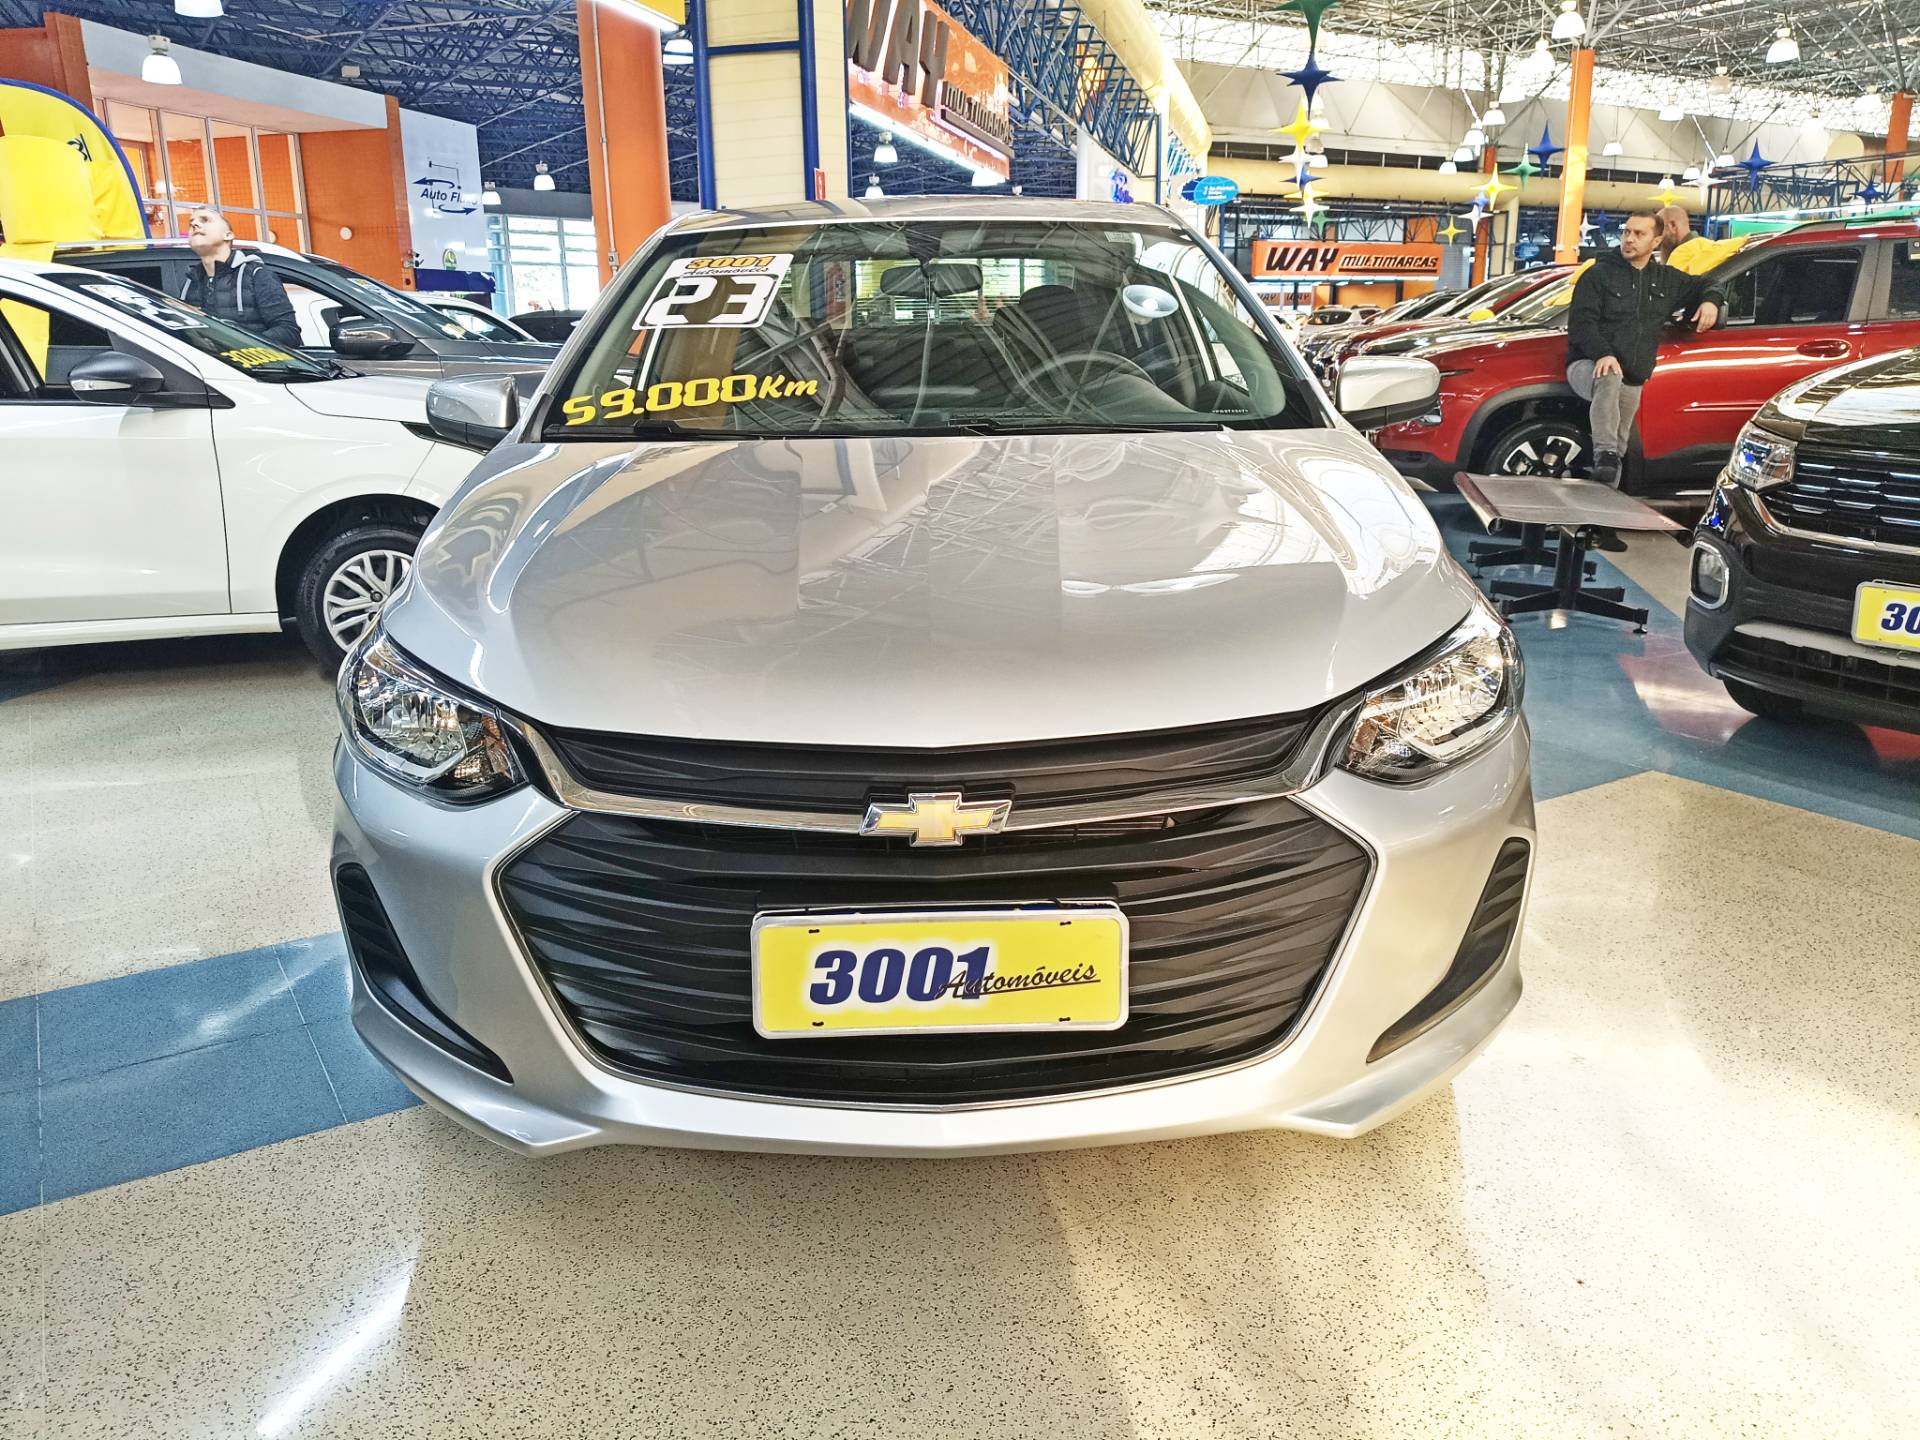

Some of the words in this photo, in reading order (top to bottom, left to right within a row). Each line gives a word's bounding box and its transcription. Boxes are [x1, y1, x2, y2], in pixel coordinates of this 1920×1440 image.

[420, 188, 447, 201] Auto
[684, 255, 776, 270] 3001
[1265, 246, 1339, 272] WAY
[1340, 254, 1438, 268] MULTIMARCAS
[644, 275, 775, 325] 23
[809, 946, 990, 1005] 3001
